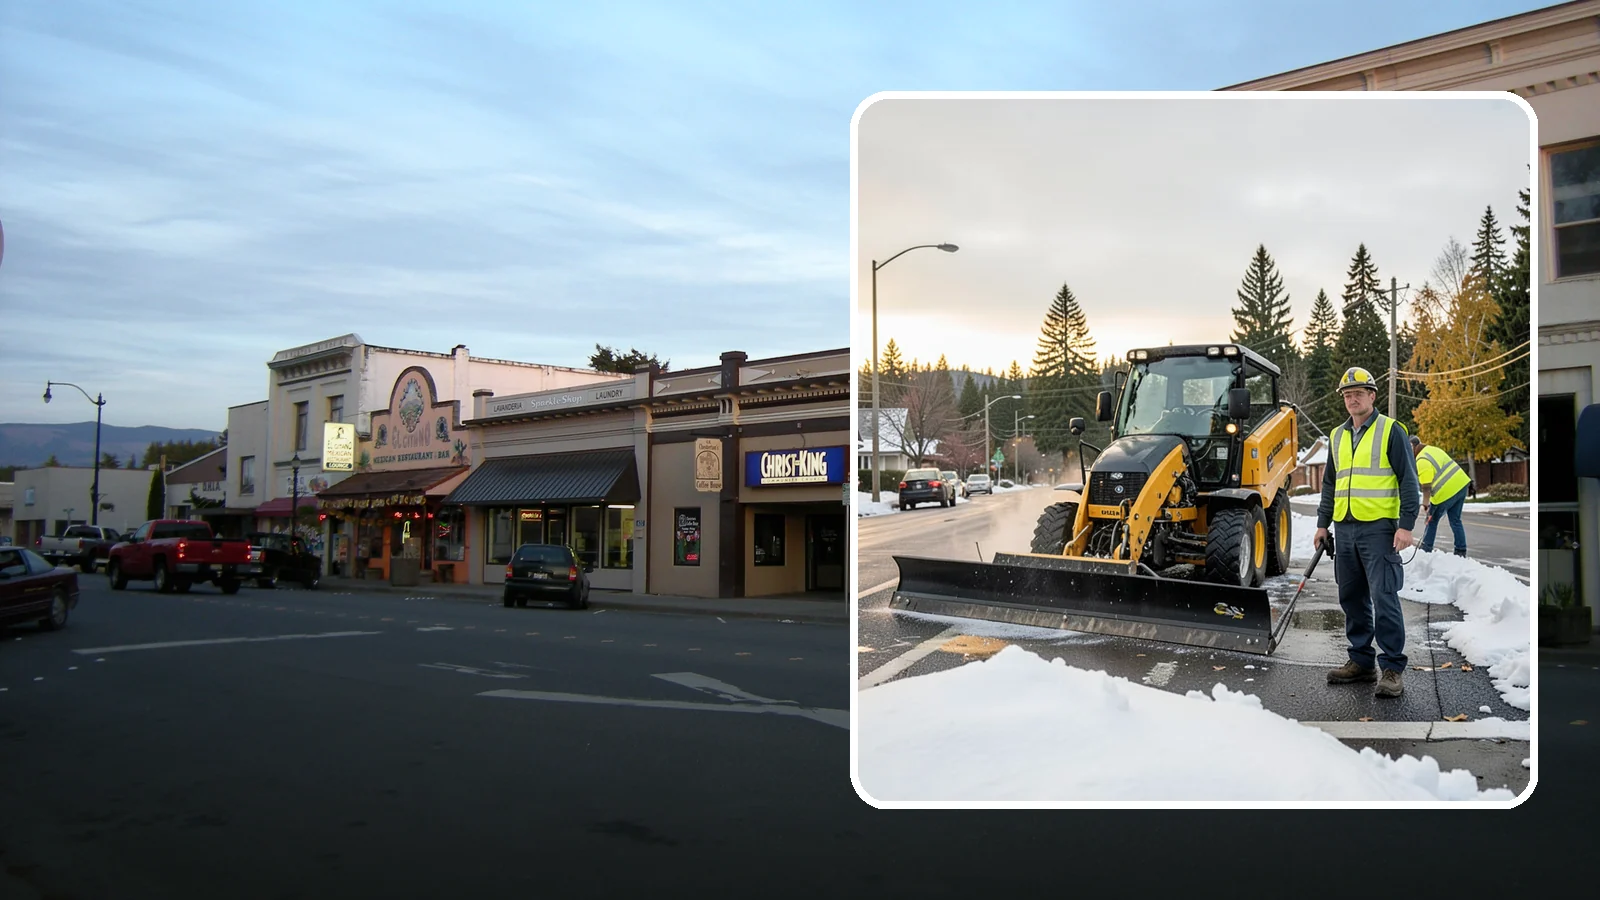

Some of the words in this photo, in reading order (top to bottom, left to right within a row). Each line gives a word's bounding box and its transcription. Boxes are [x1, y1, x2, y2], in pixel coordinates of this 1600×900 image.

[562, 394, 582, 405] Shop
[595, 389, 623, 399] LAUNDRY
[493, 402, 522, 412] LAVANDERIA
[373, 455, 396, 464] MEXICAN
[397, 451, 433, 462] RESTAURANT
[437, 450, 450, 459] BAR
[761, 452, 797, 478] CHRIST
[799, 450, 827, 476] KING
